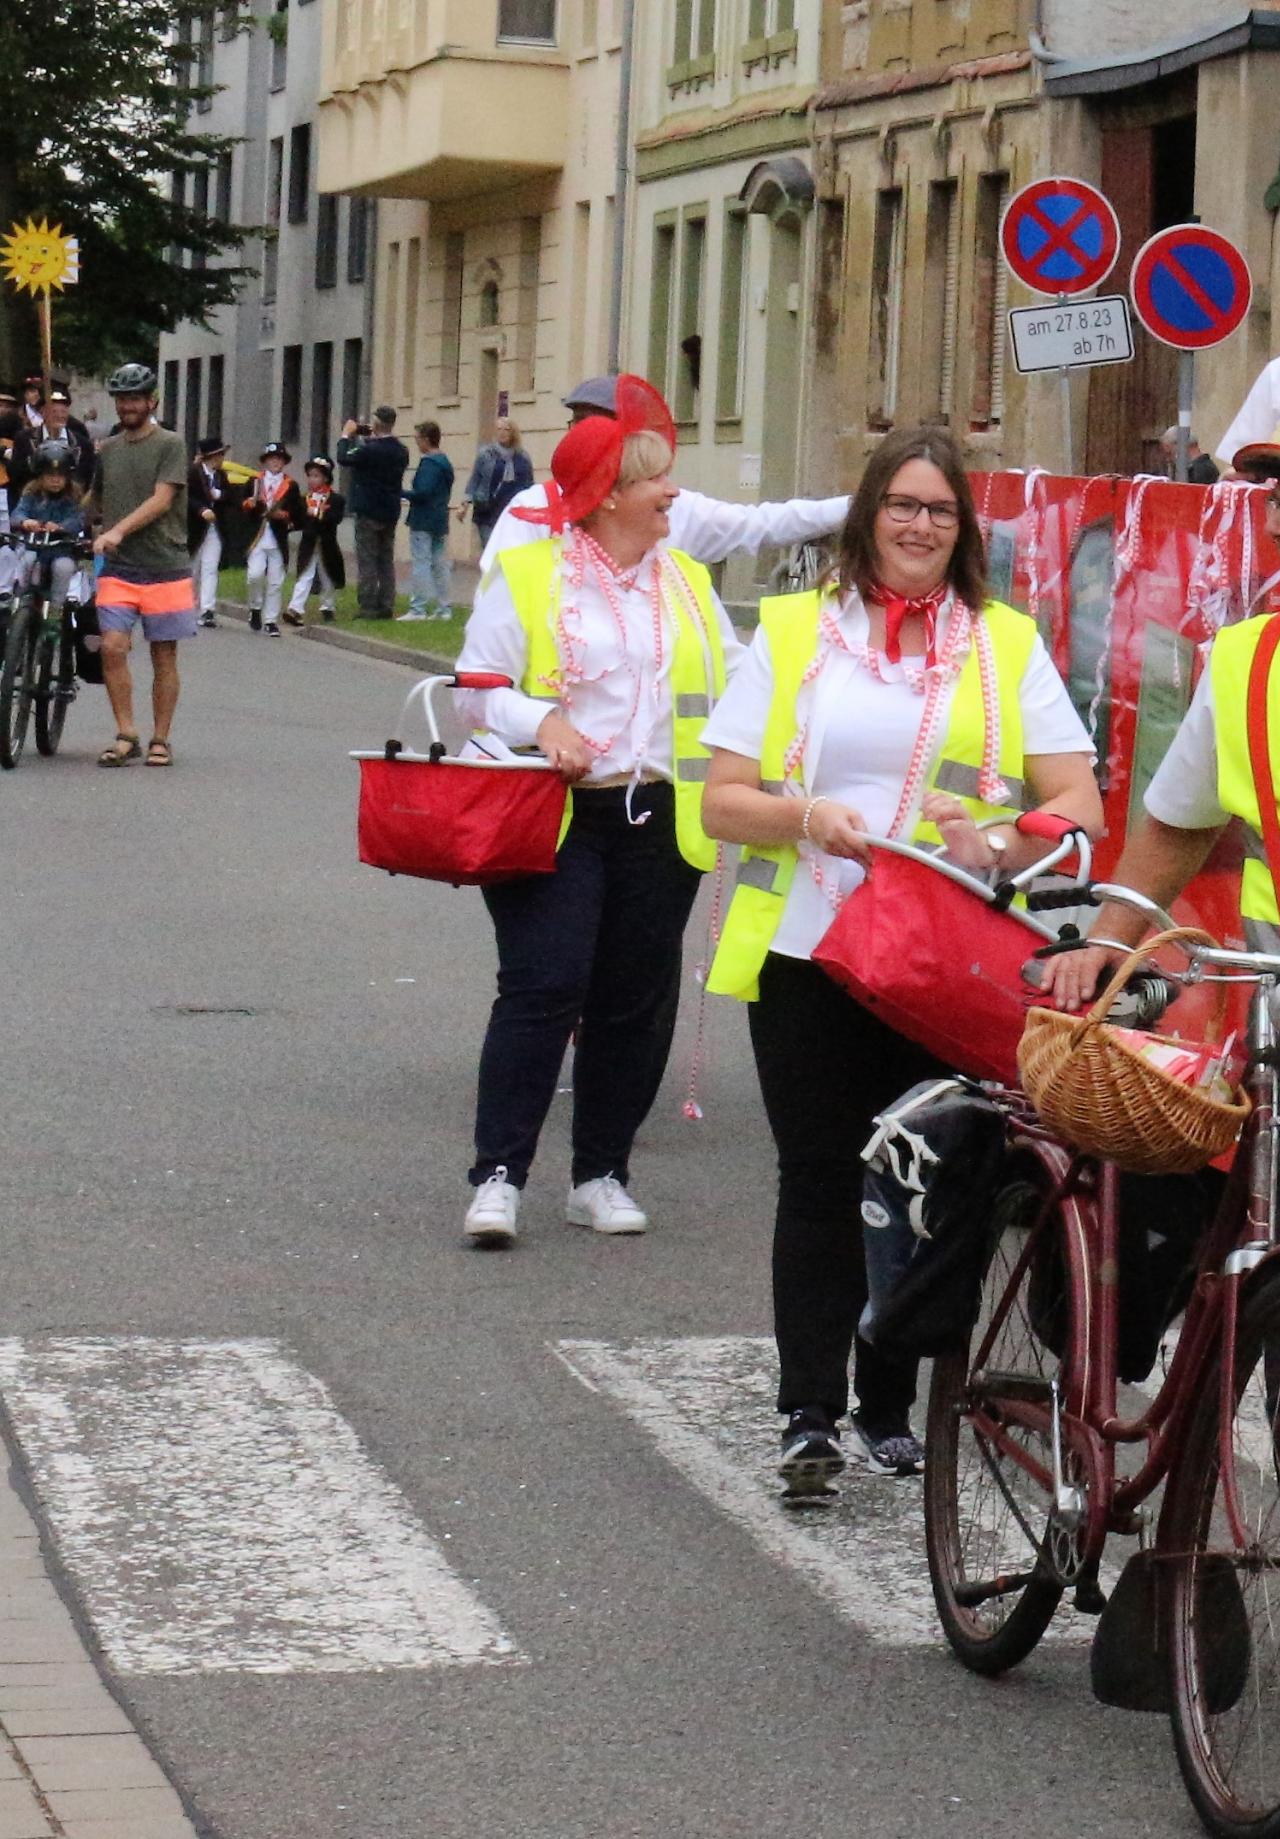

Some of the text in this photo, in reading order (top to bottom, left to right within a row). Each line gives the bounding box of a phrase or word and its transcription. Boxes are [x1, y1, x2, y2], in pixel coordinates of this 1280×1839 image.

[1027, 308, 1113, 336] am 27.8.23
[1073, 334, 1116, 356] ab 7h
